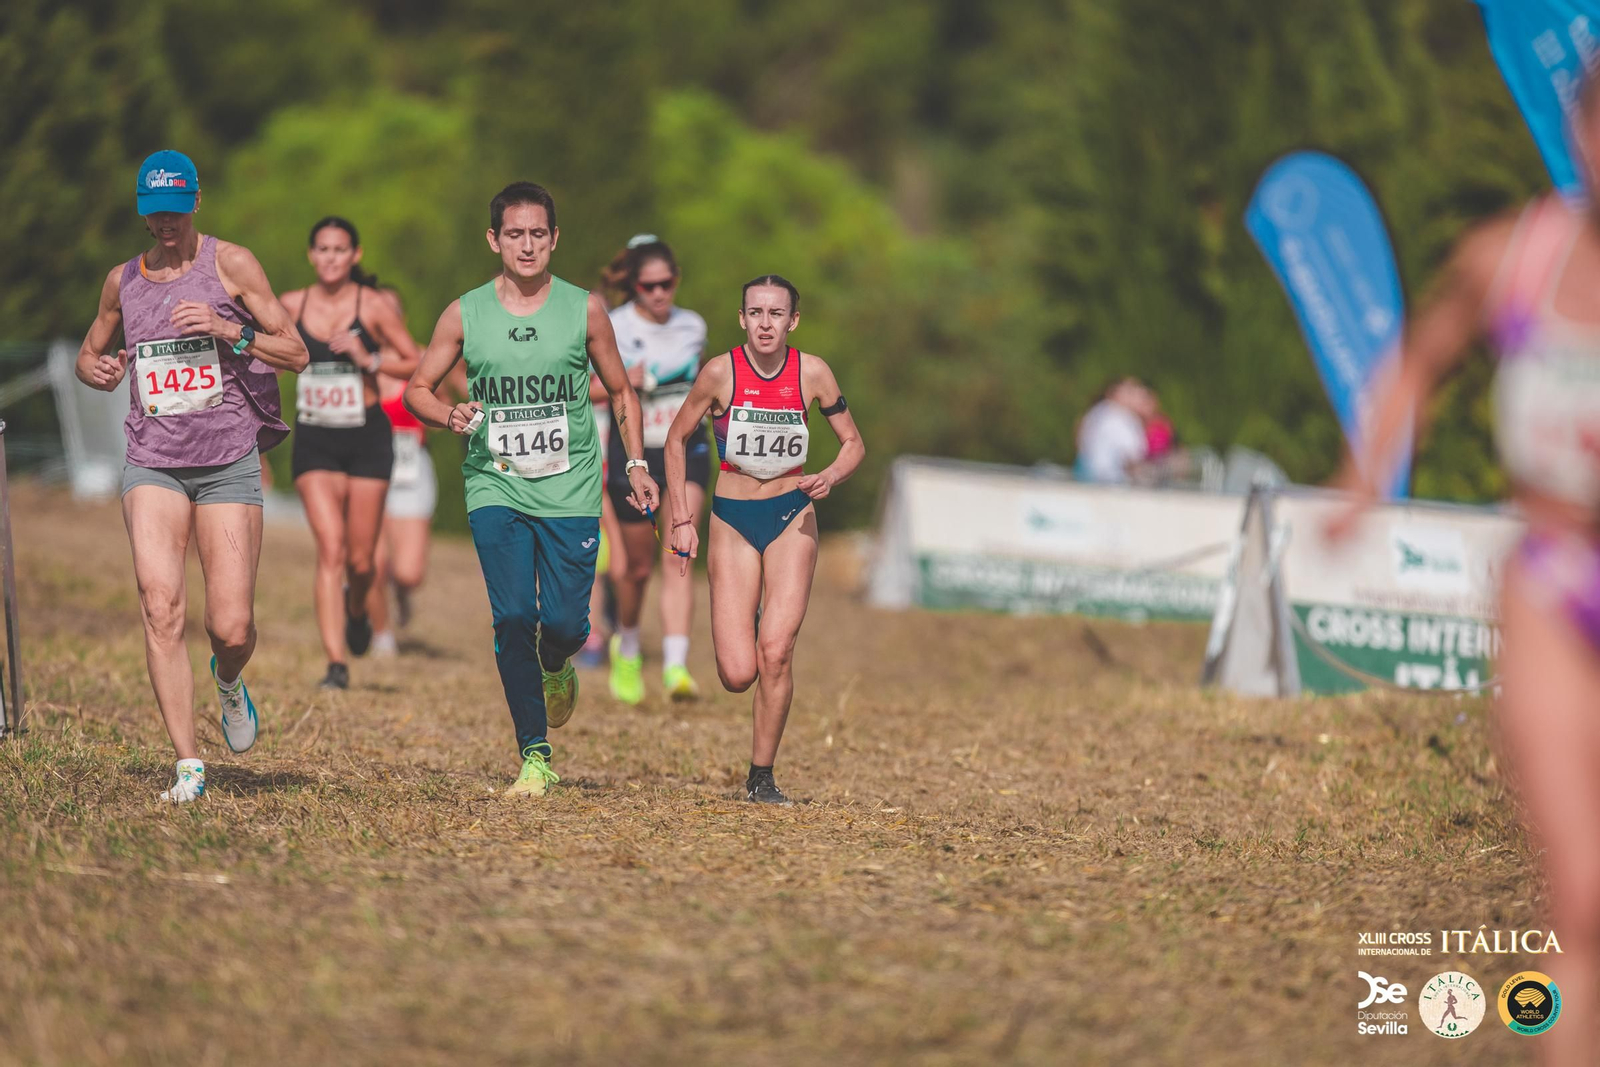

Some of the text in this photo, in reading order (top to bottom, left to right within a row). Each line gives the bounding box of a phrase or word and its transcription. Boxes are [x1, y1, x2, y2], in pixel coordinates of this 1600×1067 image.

[156, 342, 195, 355] ITÁLICA
[146, 365, 216, 395] 1425
[472, 374, 578, 404] MARISCAL
[304, 385, 356, 408] 1501
[510, 408, 547, 420] ITÁLICA
[753, 411, 790, 423] ITÁLICA
[498, 428, 564, 457] 1146
[735, 433, 803, 458] 1146
[1306, 606, 1500, 659] CROSS INTERN
[1394, 655, 1481, 692] ITÁL
